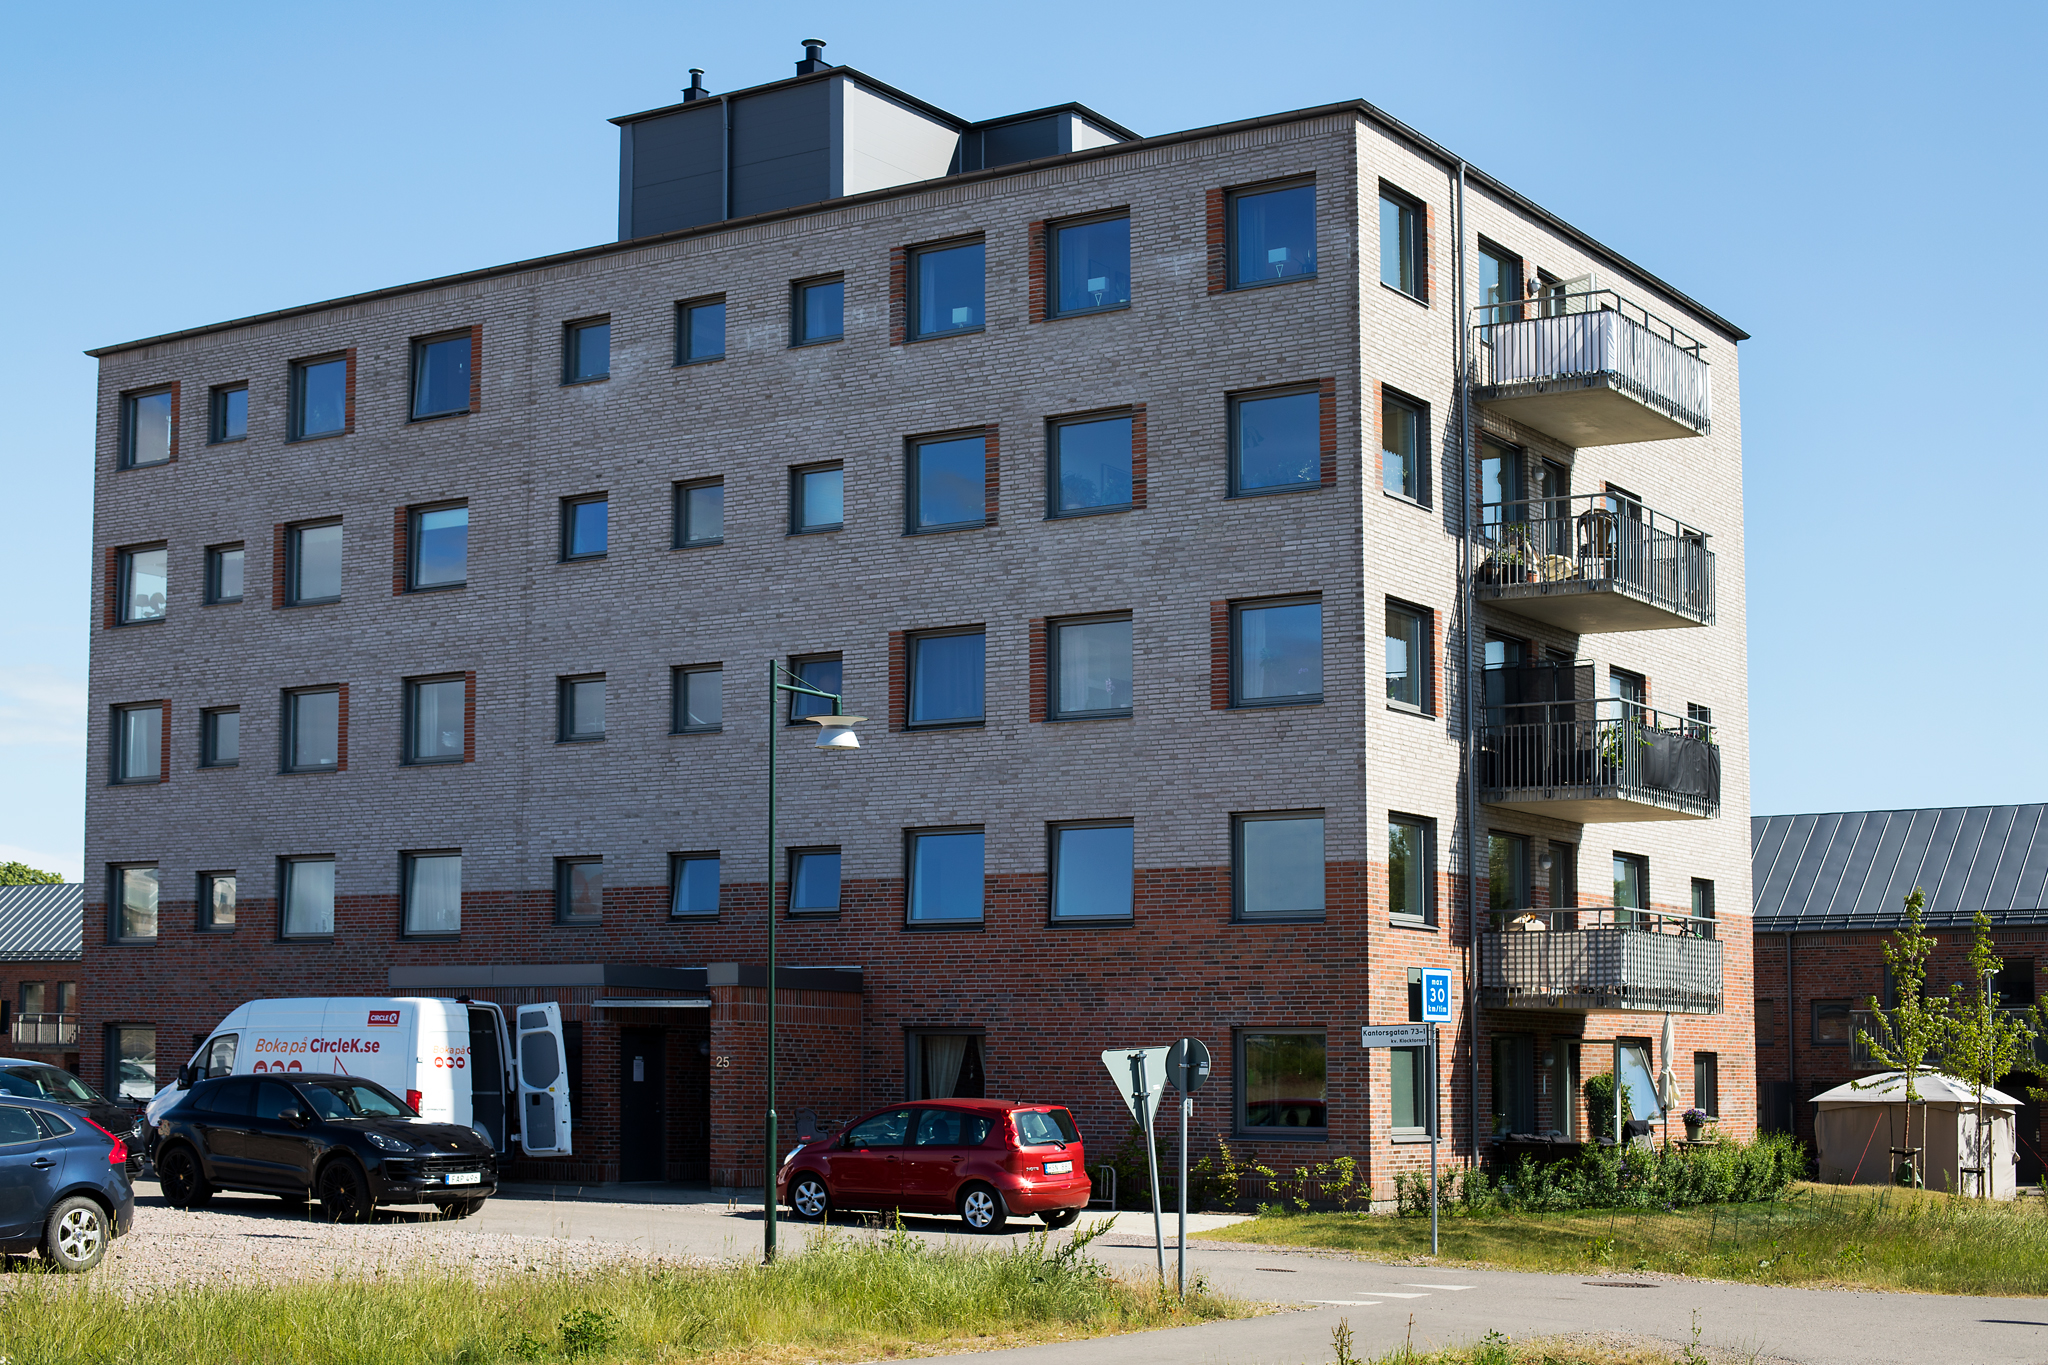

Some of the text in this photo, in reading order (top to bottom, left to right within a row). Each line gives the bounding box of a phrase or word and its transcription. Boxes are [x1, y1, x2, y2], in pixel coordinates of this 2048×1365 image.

[1429, 987, 1445, 1003] 30
[1428, 1004, 1447, 1013] km/tim
[370, 1014, 389, 1022] CIRCLE
[1362, 1028, 1409, 1037] Kantorsgatan
[254, 1036, 380, 1056] Boka på CircleK.se
[433, 1045, 454, 1054] Boka
[455, 1045, 466, 1056] på
[716, 1055, 730, 1068] 25
